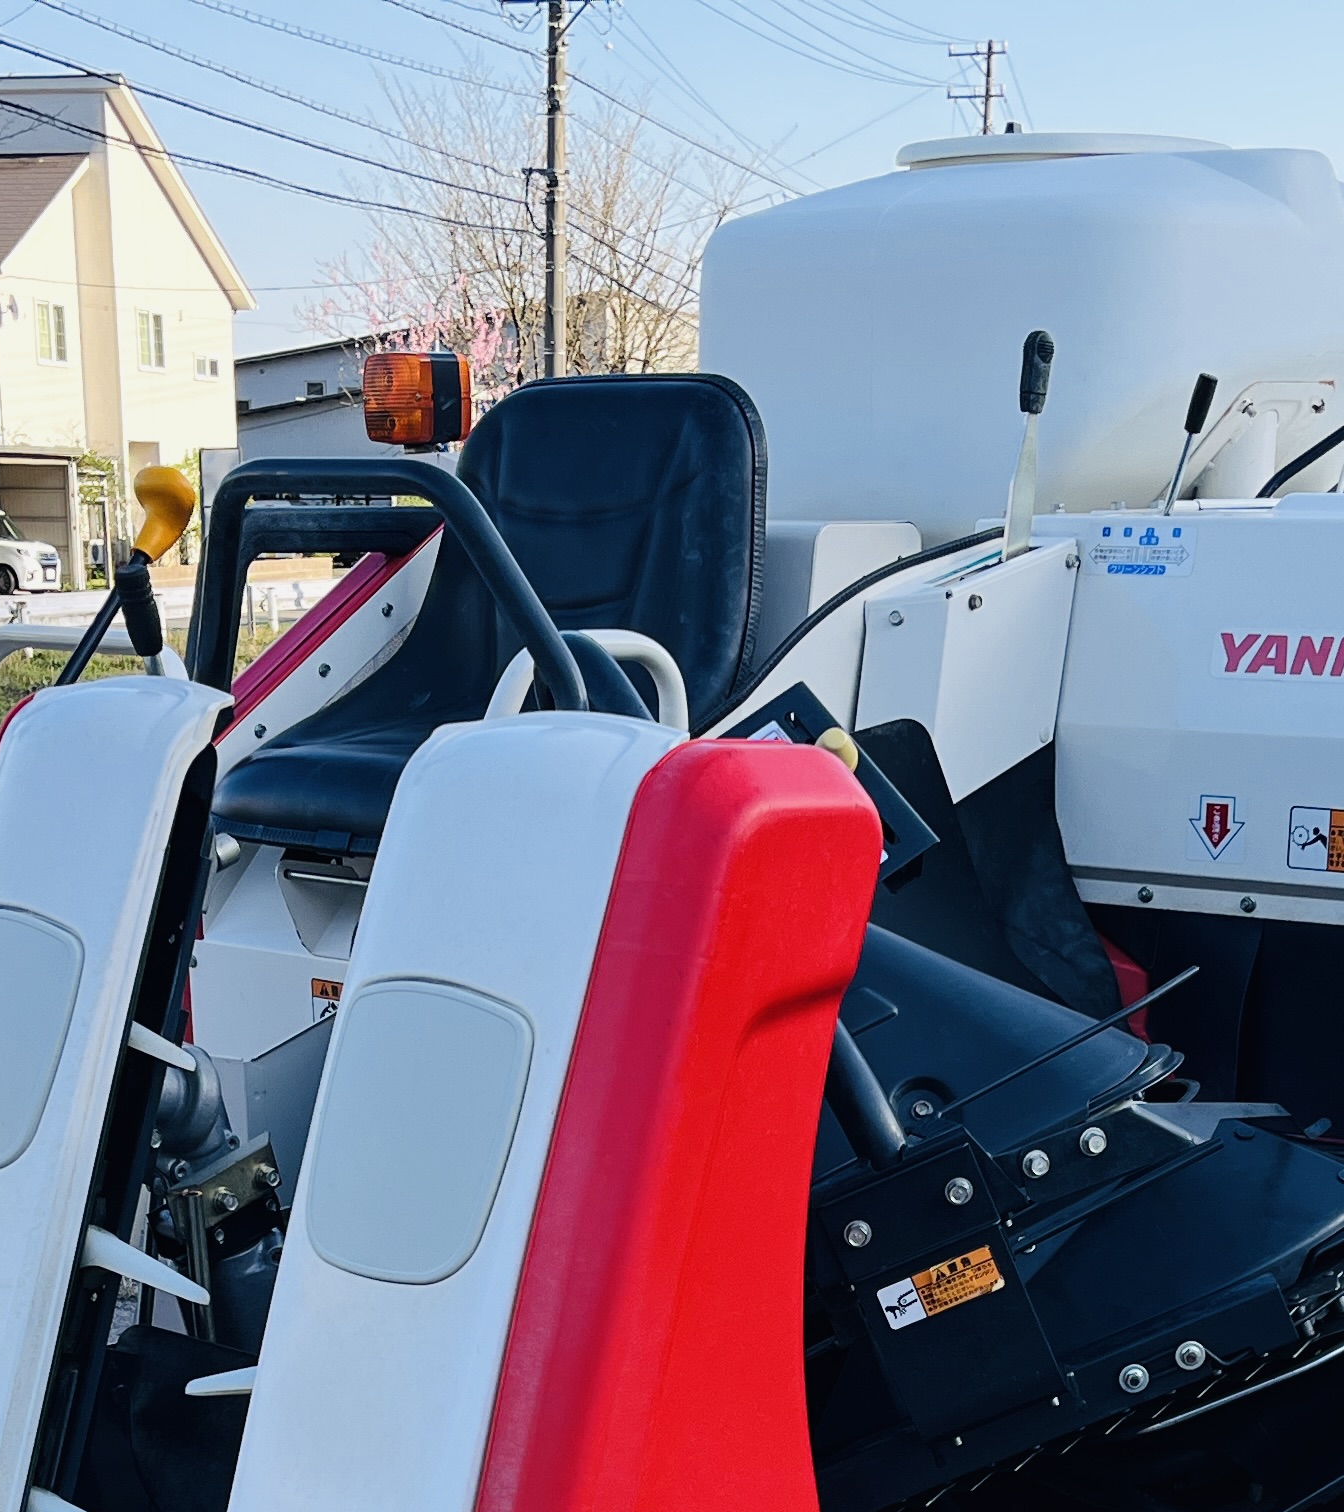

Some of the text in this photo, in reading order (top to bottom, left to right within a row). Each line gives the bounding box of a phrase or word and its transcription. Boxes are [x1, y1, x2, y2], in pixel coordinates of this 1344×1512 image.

[1109, 564, 1165, 575] クリーンシフト
